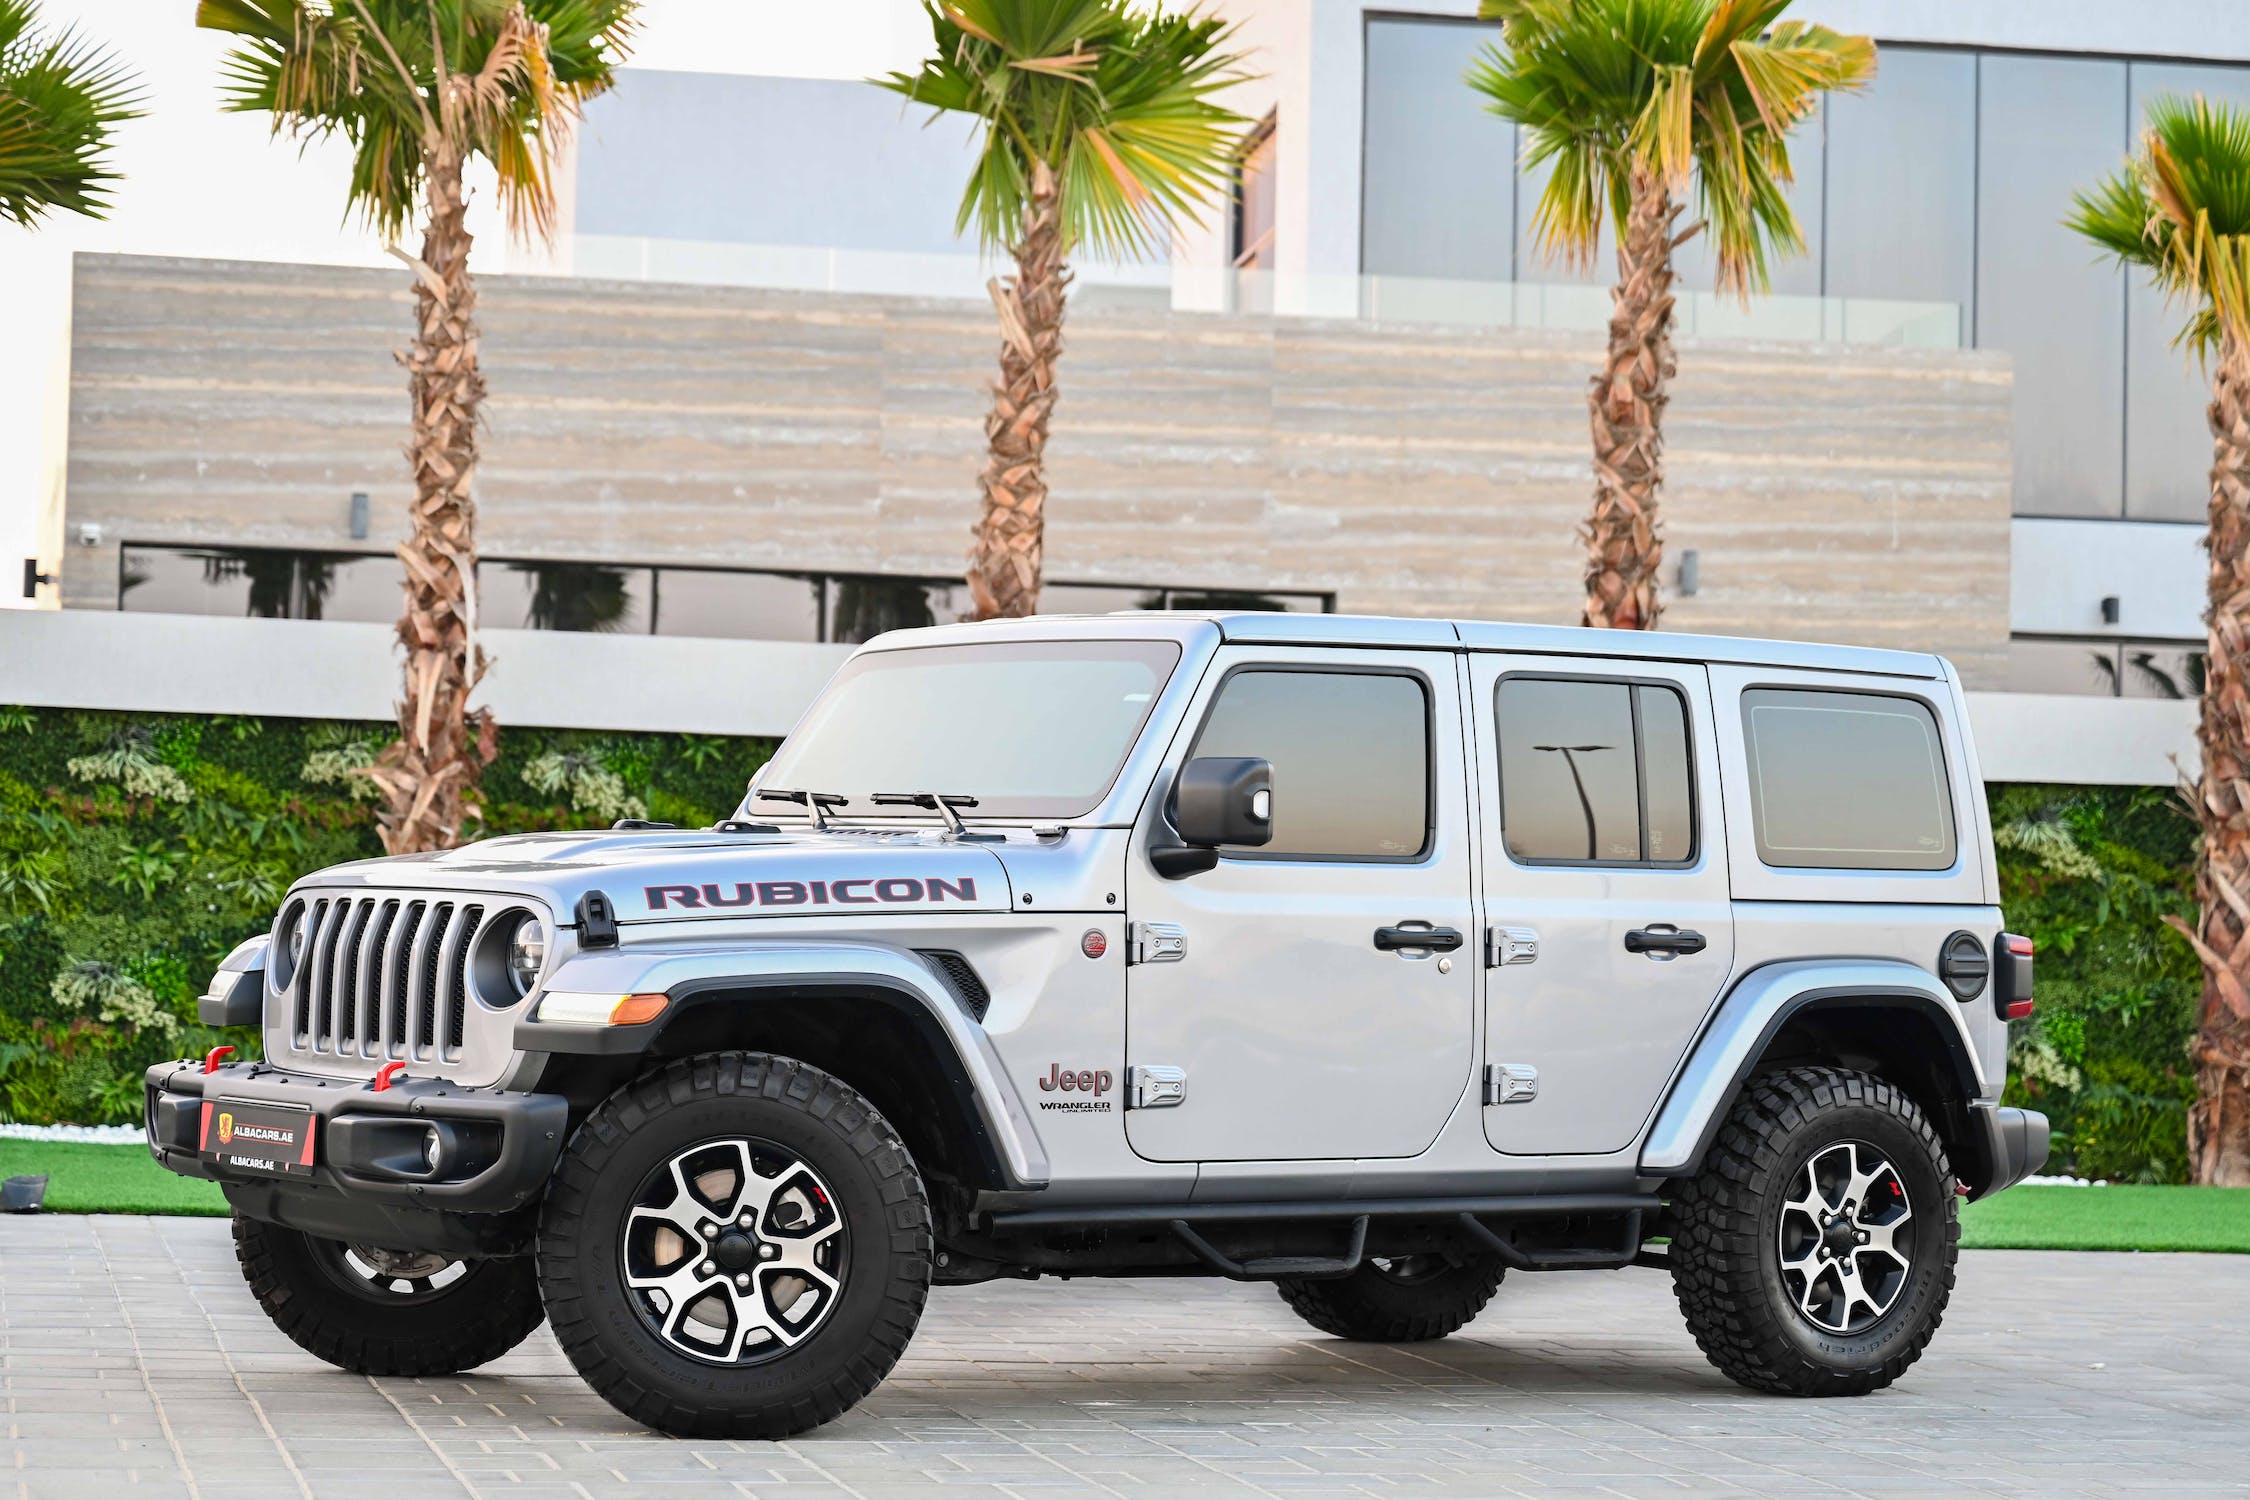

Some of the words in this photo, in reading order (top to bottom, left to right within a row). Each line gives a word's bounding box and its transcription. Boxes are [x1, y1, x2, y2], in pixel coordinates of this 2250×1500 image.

[643, 877, 977, 910] RUBICON
[1039, 1063, 1113, 1096] Jeep
[1039, 1102, 1111, 1110] WRANGLER
[233, 1126, 294, 1142] ALBACARS.AE
[230, 1155, 275, 1170] ALBACARS.AE
